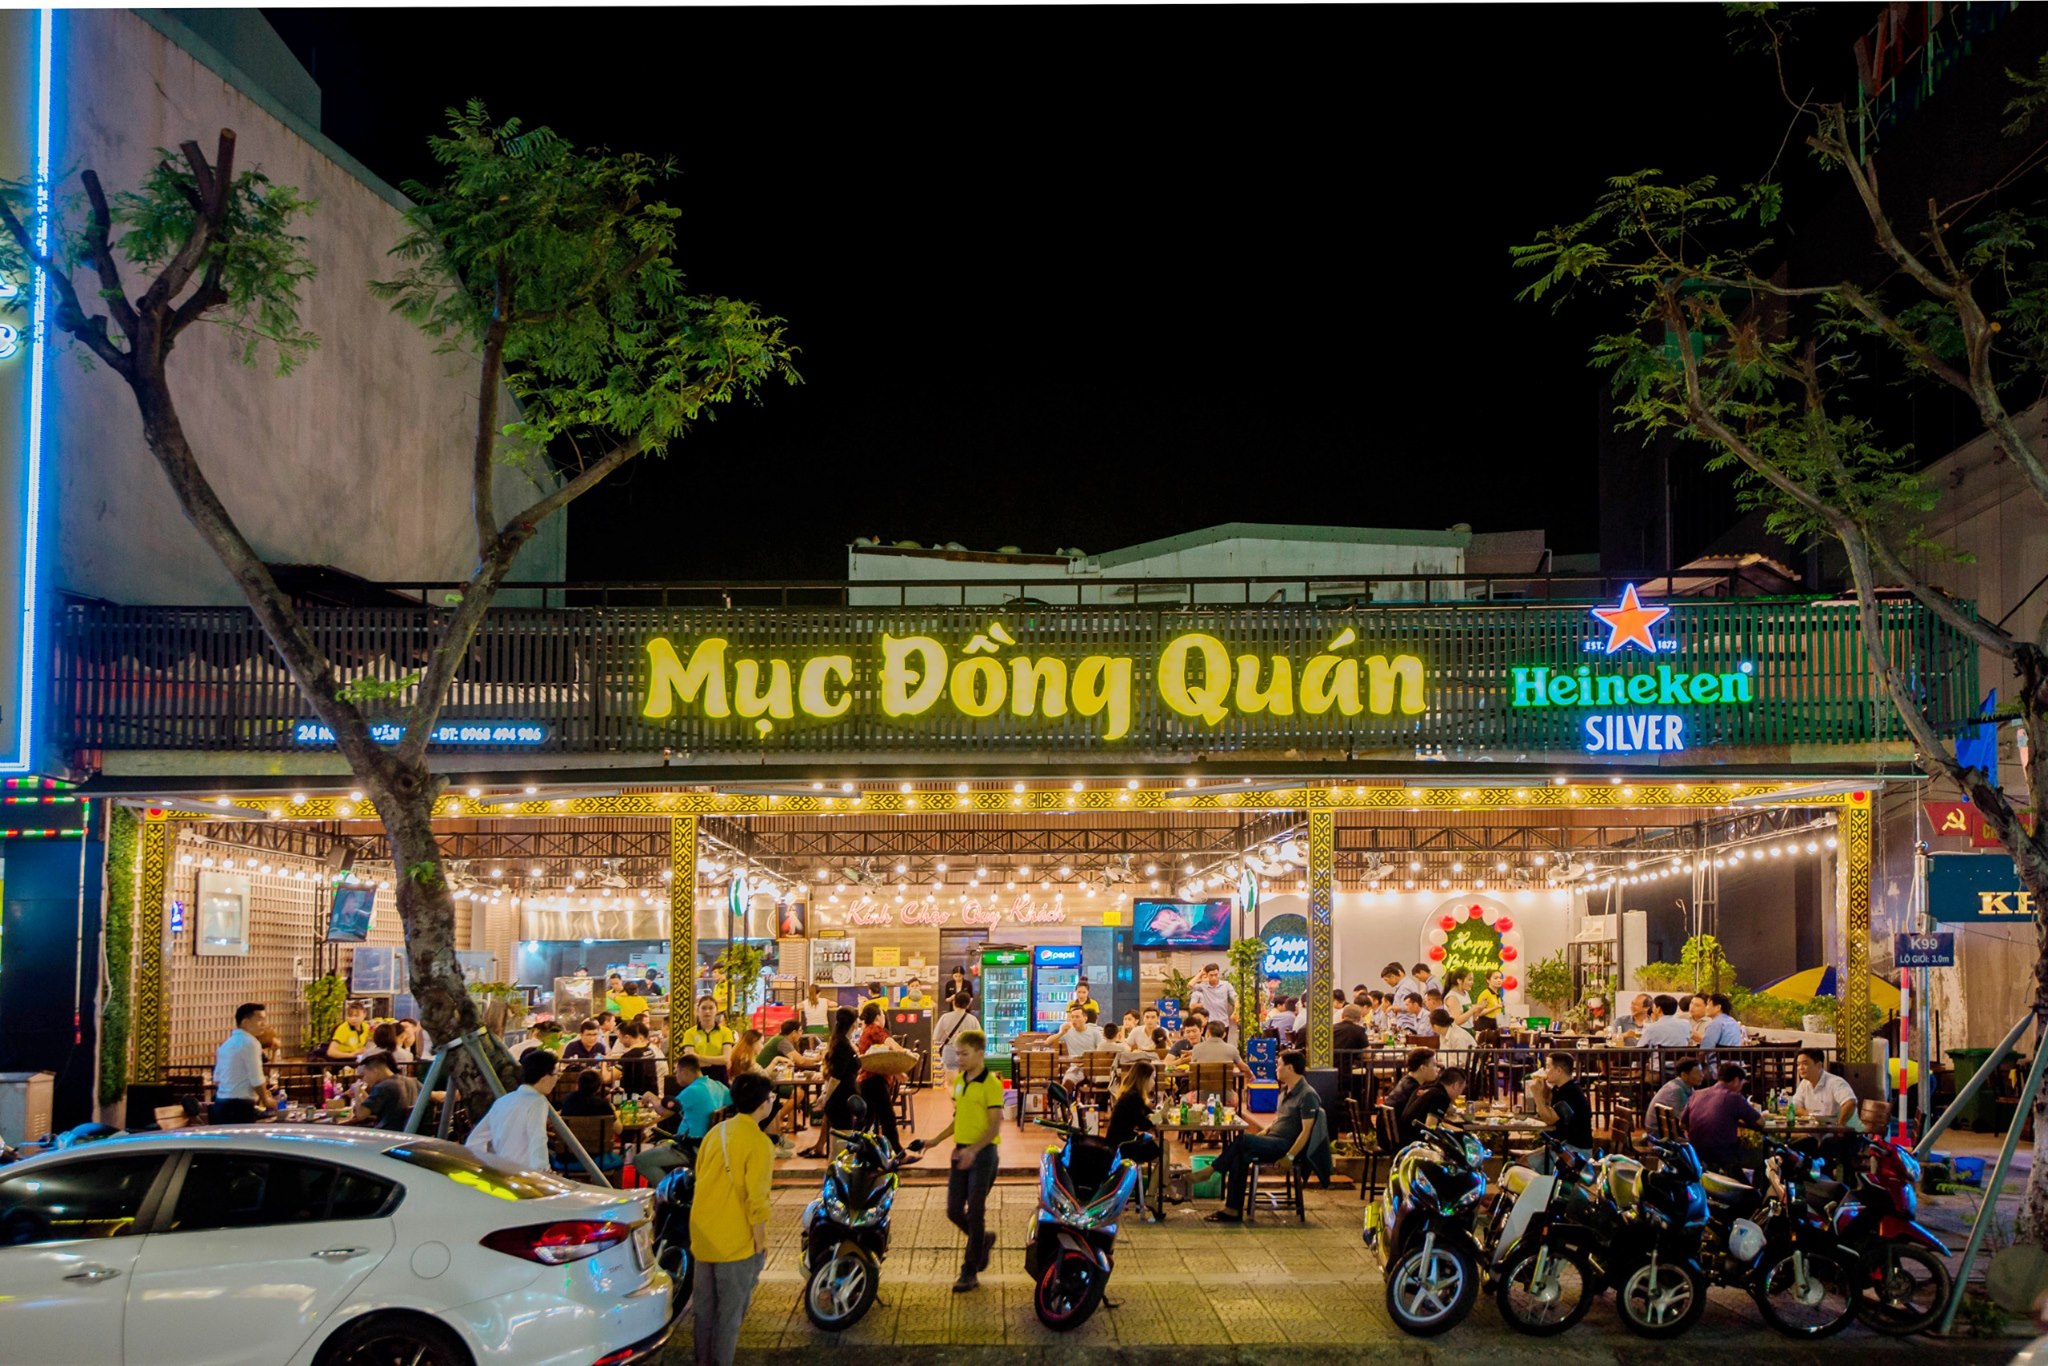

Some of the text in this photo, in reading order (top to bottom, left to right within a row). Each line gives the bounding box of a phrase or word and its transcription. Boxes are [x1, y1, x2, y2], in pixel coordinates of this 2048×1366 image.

[1585, 640, 1677, 650] EST. 1873
[643, 637, 853, 740] Mục
[1158, 627, 1426, 726] Quán
[1511, 665, 1753, 706] Heineken
[298, 725, 317, 740] 24
[460, 727, 491, 740] 0968
[492, 727, 516, 740] 494
[1586, 715, 1684, 750] SILVER
[1910, 938, 1938, 950] K99
[1052, 951, 1076, 960] pepsi
[1931, 954, 1950, 963] 3.0m
